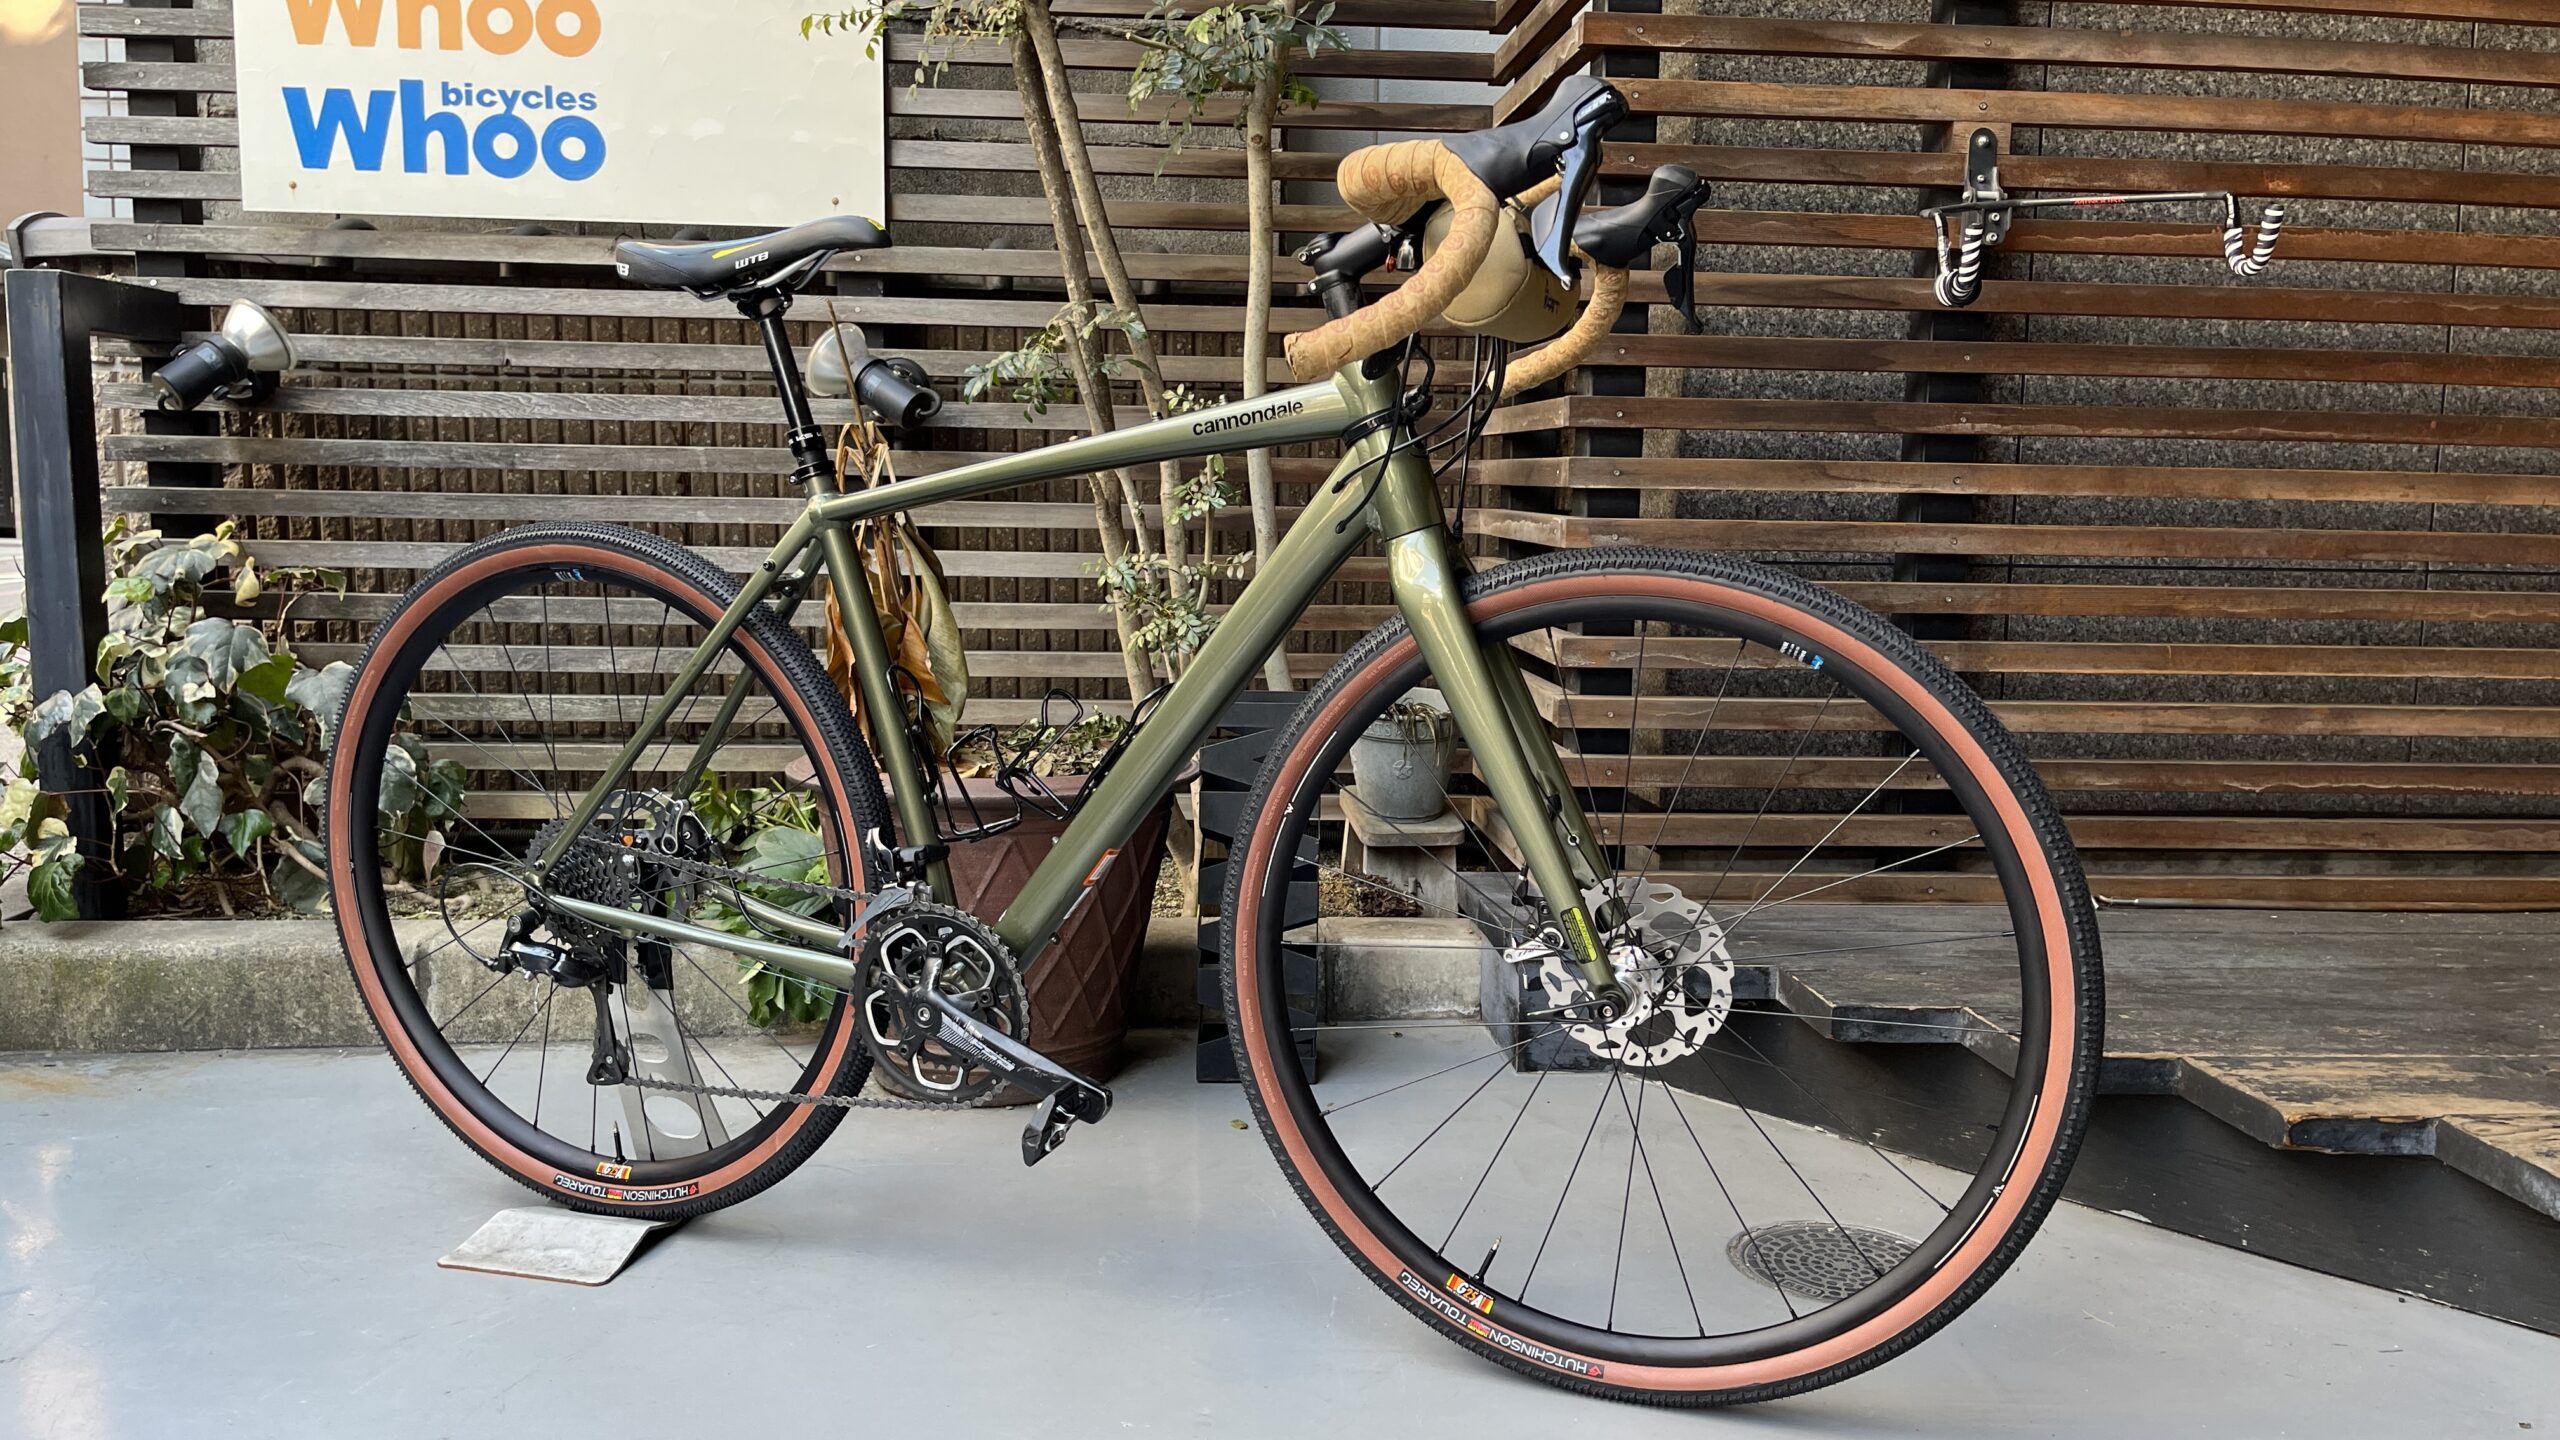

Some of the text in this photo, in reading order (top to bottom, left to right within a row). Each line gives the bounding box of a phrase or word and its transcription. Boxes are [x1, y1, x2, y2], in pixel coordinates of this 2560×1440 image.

[441, 81, 598, 114] bicycles
[735, 251, 769, 270] WTB
[1192, 401, 1304, 436] cannondale
[555, 1175, 606, 1197] TOUAREG
[623, 1186, 689, 1200] HUTCHINSON
[1401, 1271, 1467, 1325] TOUAREG
[1489, 1328, 1588, 1373] HUTCHINSON
